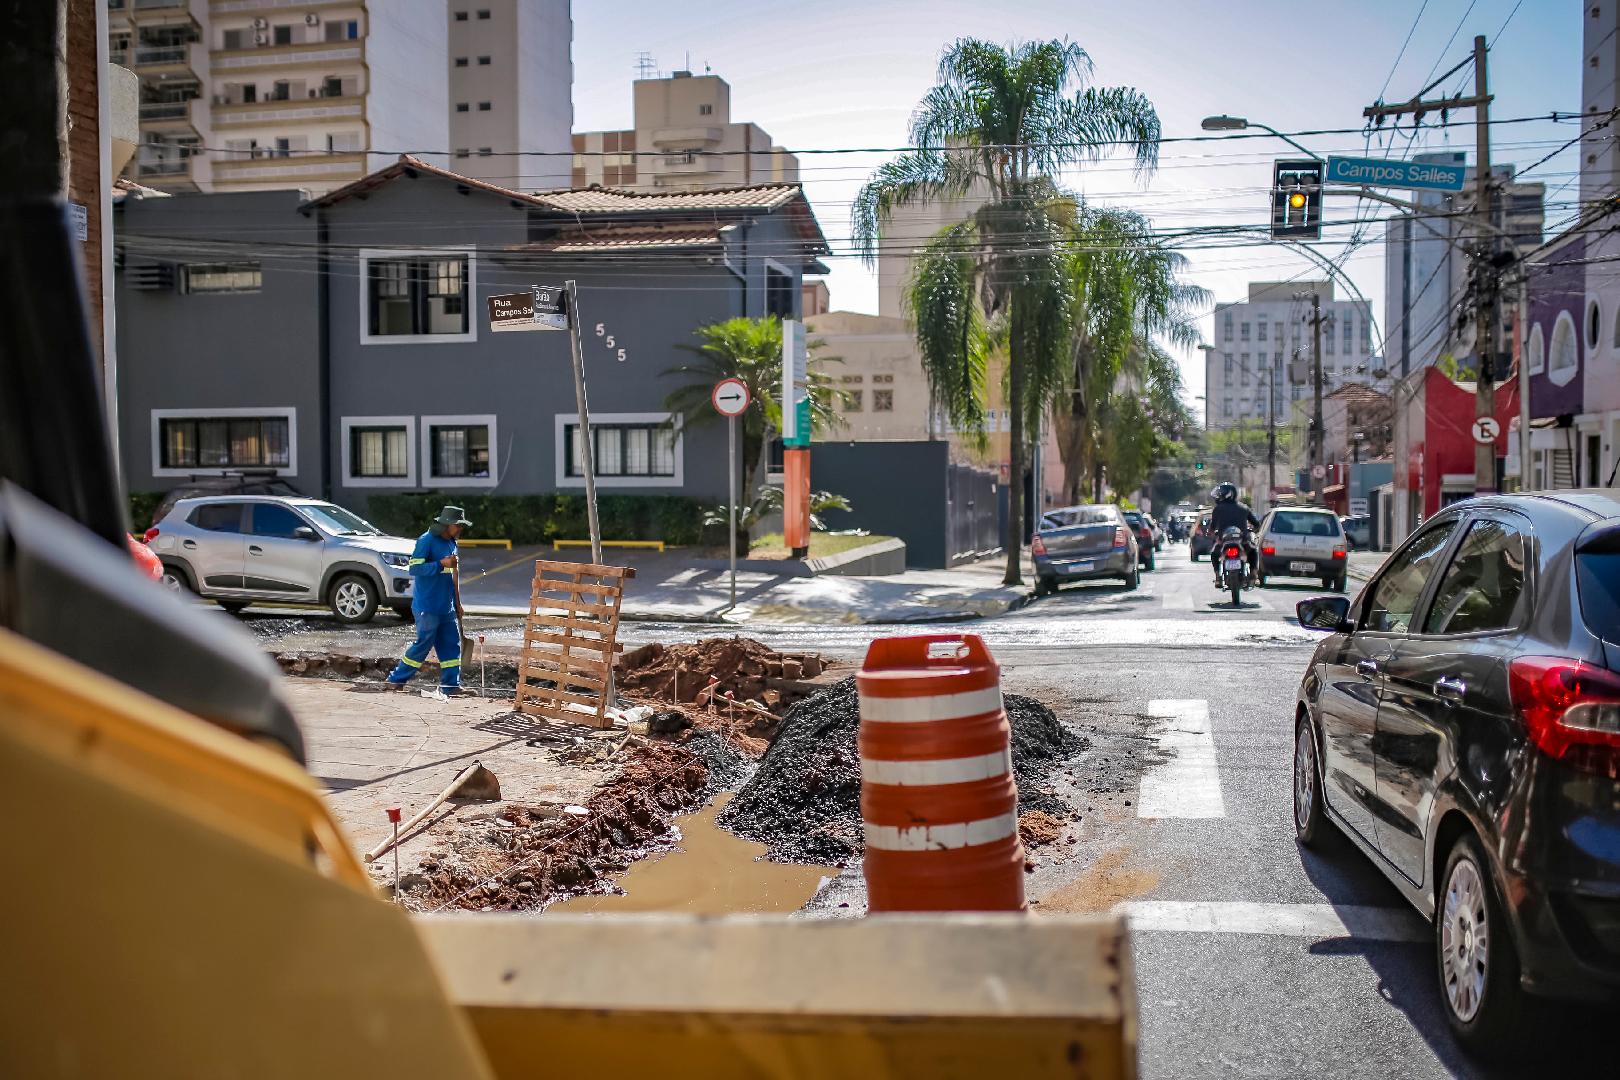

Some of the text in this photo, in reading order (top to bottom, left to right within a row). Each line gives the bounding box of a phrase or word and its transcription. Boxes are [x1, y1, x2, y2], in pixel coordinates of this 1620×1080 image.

[1337, 160, 1457, 185] Campos Salles
[494, 299, 512, 308] Rua
[495, 308, 522, 317] Campos
